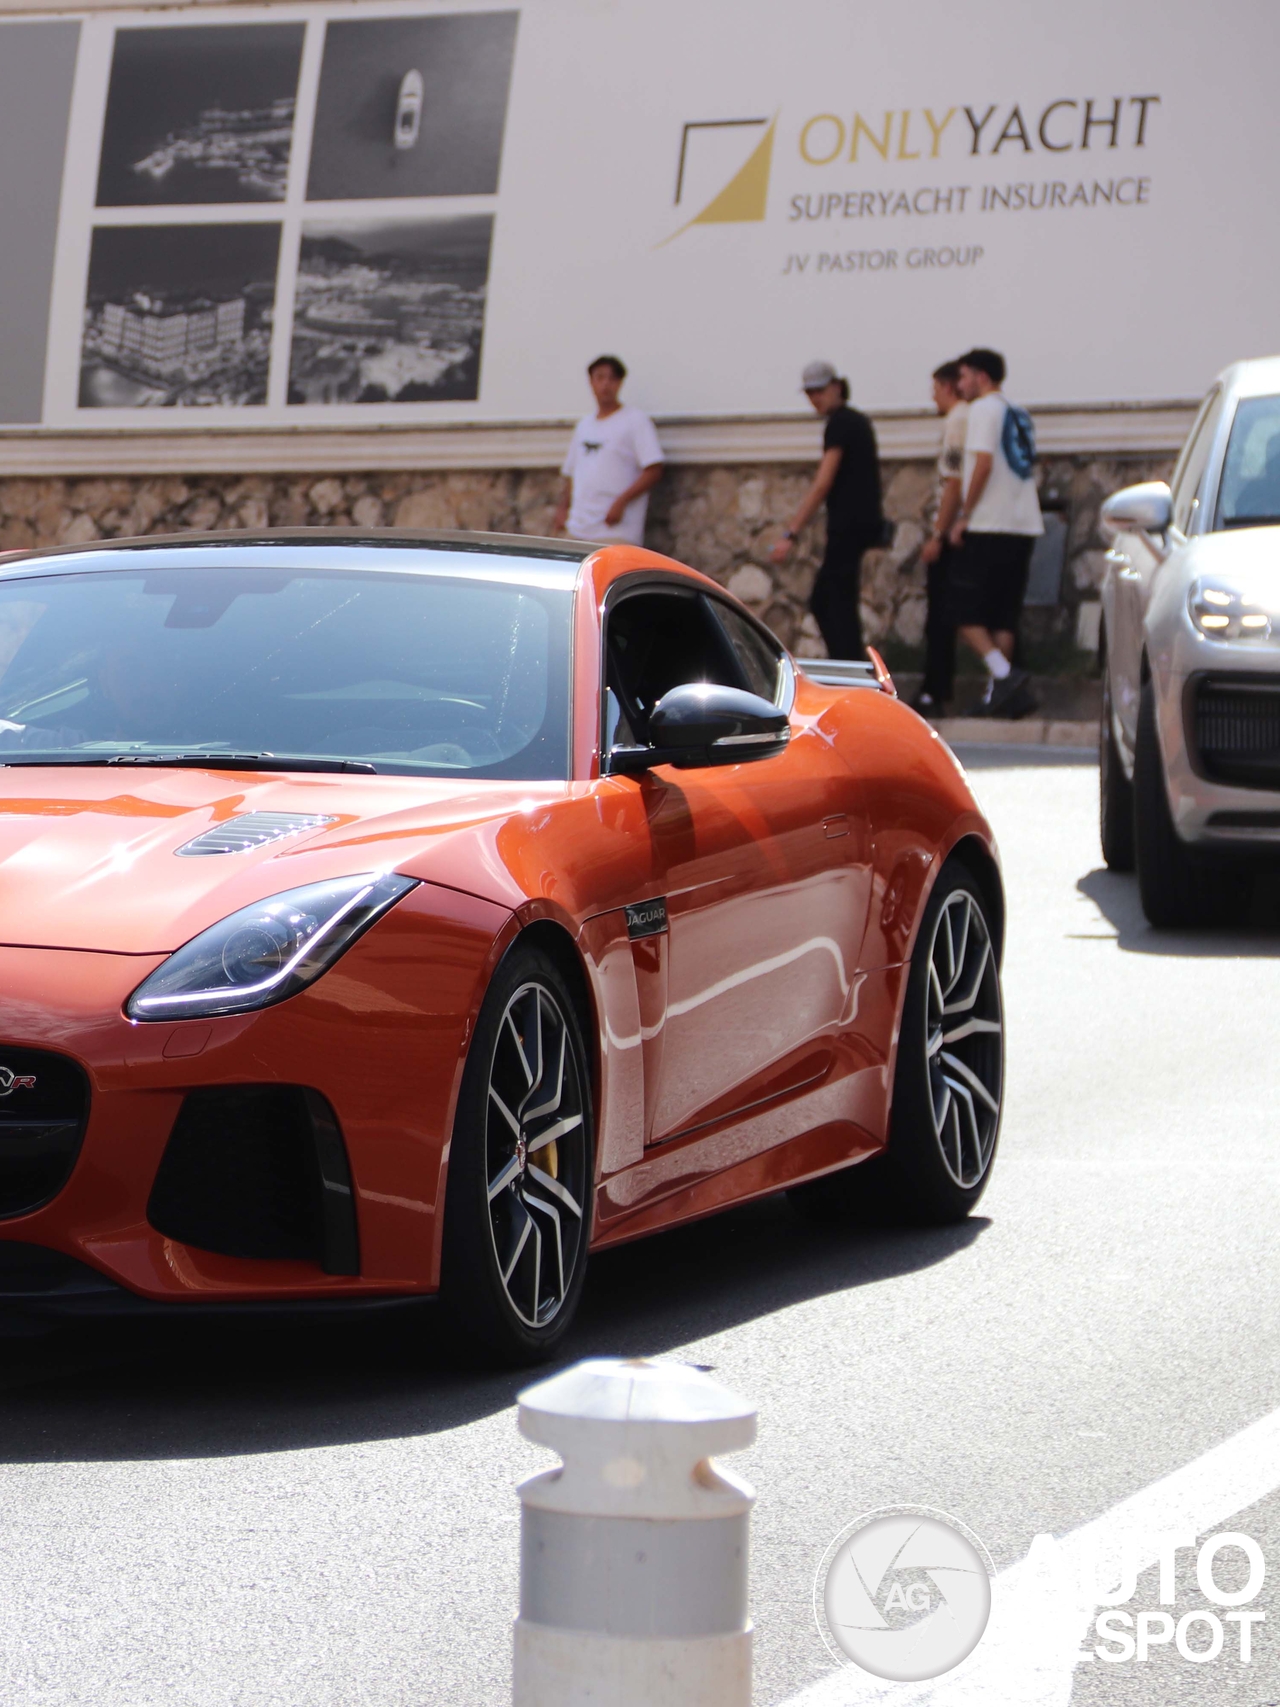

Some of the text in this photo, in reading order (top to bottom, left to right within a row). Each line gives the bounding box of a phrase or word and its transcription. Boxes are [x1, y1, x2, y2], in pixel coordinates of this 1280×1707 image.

[799, 96, 1160, 165] ONLYYACHT
[788, 177, 1151, 222] SUPERYACHT INSURANCE
[782, 245, 984, 275] JV PASTOR GROUP
[627, 908, 666, 927] JAGUAR
